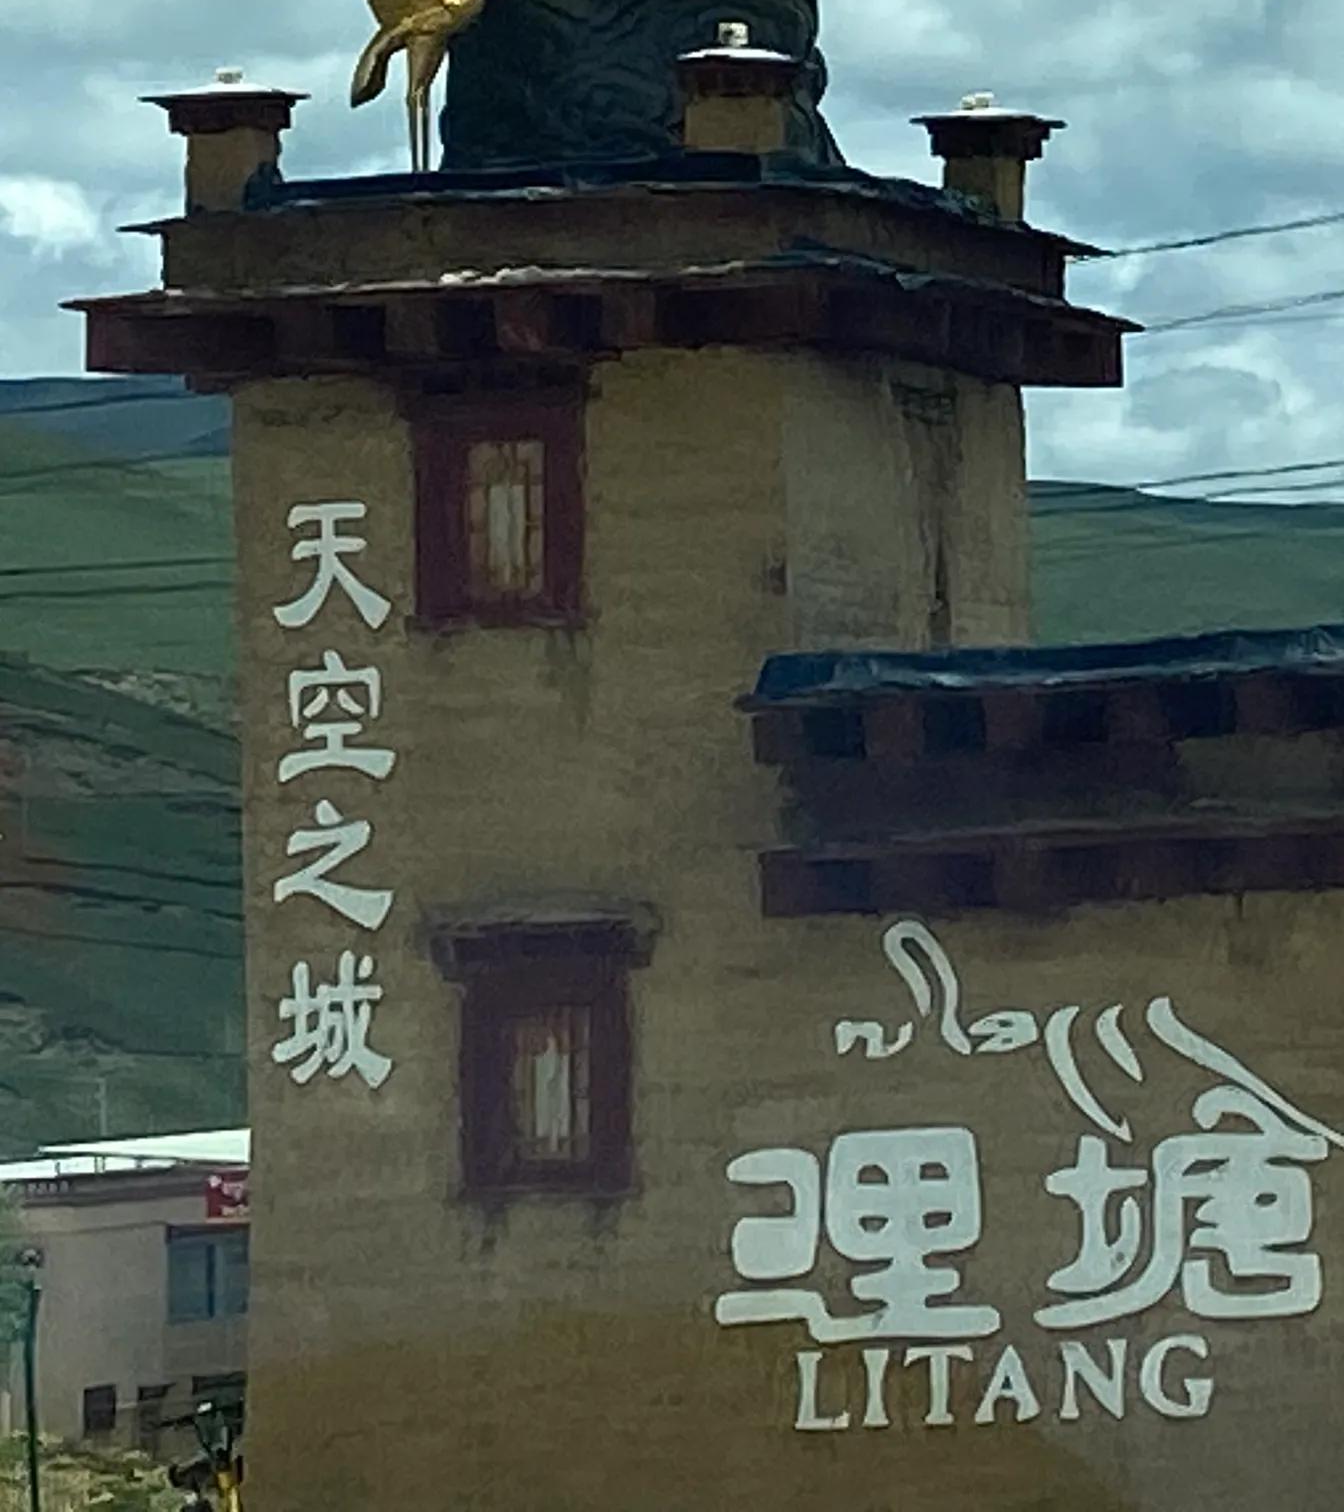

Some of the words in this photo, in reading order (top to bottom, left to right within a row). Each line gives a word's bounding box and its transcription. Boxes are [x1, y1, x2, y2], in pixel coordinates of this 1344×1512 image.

[272, 500, 395, 1089] 天空之城
[715, 1086, 1330, 1343] 理塘
[794, 1334, 1215, 1430] LITANG
